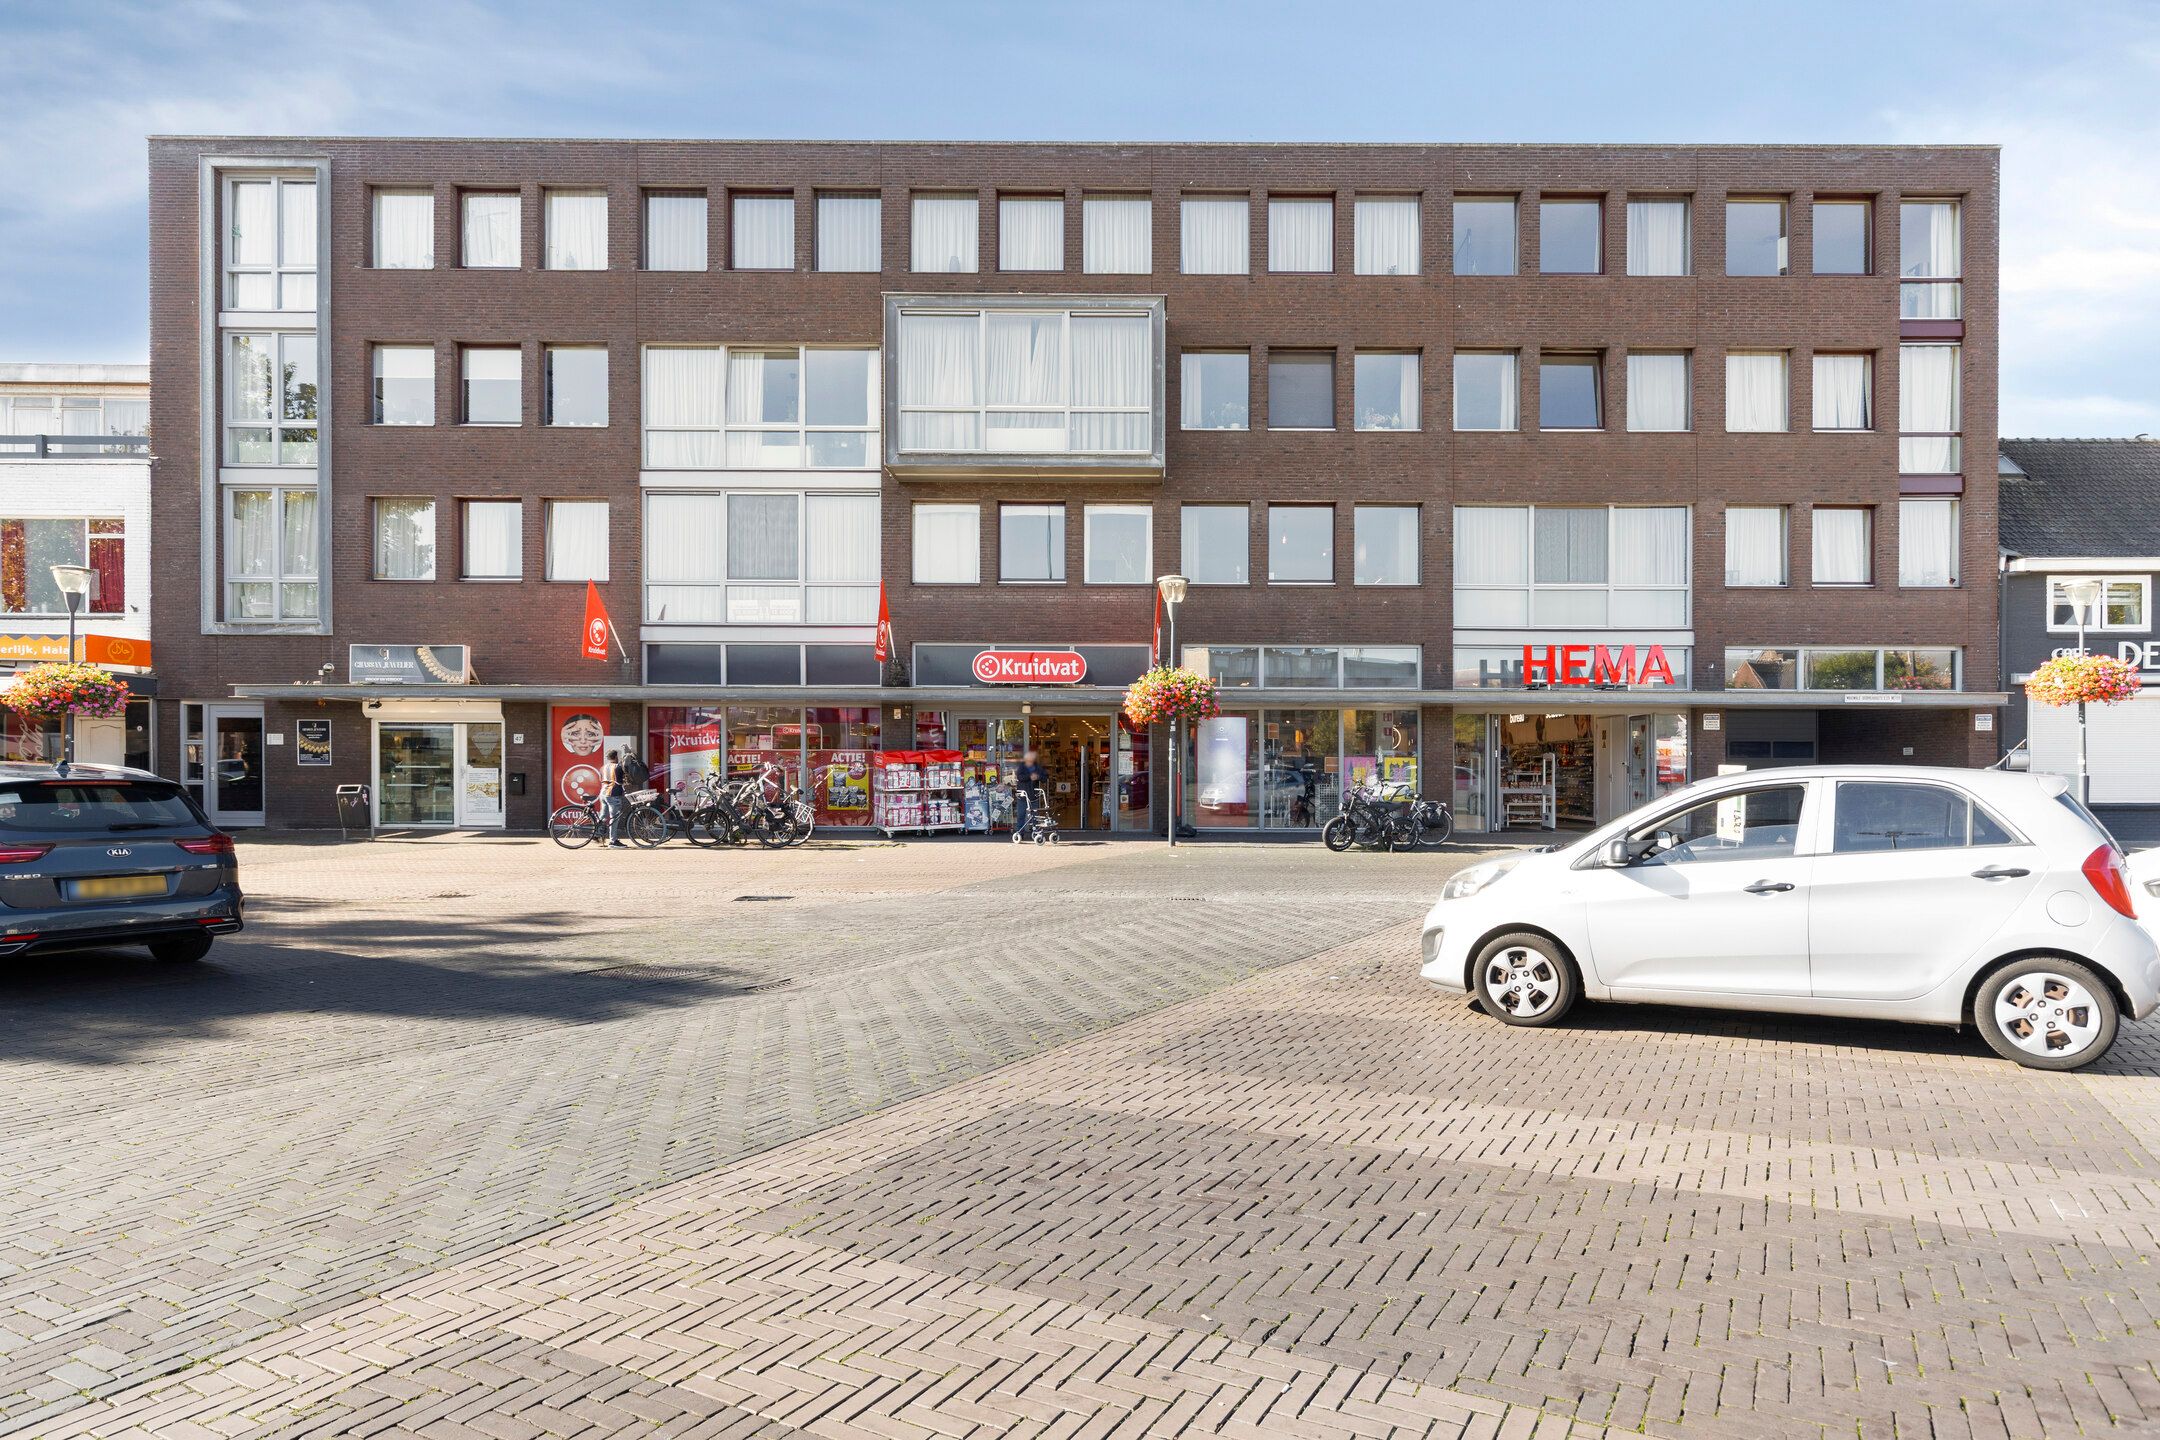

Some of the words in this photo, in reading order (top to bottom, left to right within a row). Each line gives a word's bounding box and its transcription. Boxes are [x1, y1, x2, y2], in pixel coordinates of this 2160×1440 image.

[42, 645, 71, 655] Hala
[1002, 658, 1079, 676] Kruidvat
[1523, 644, 1675, 685] HEMA
[728, 754, 760, 764] ACTIE!
[831, 753, 866, 762] ACTIE!
